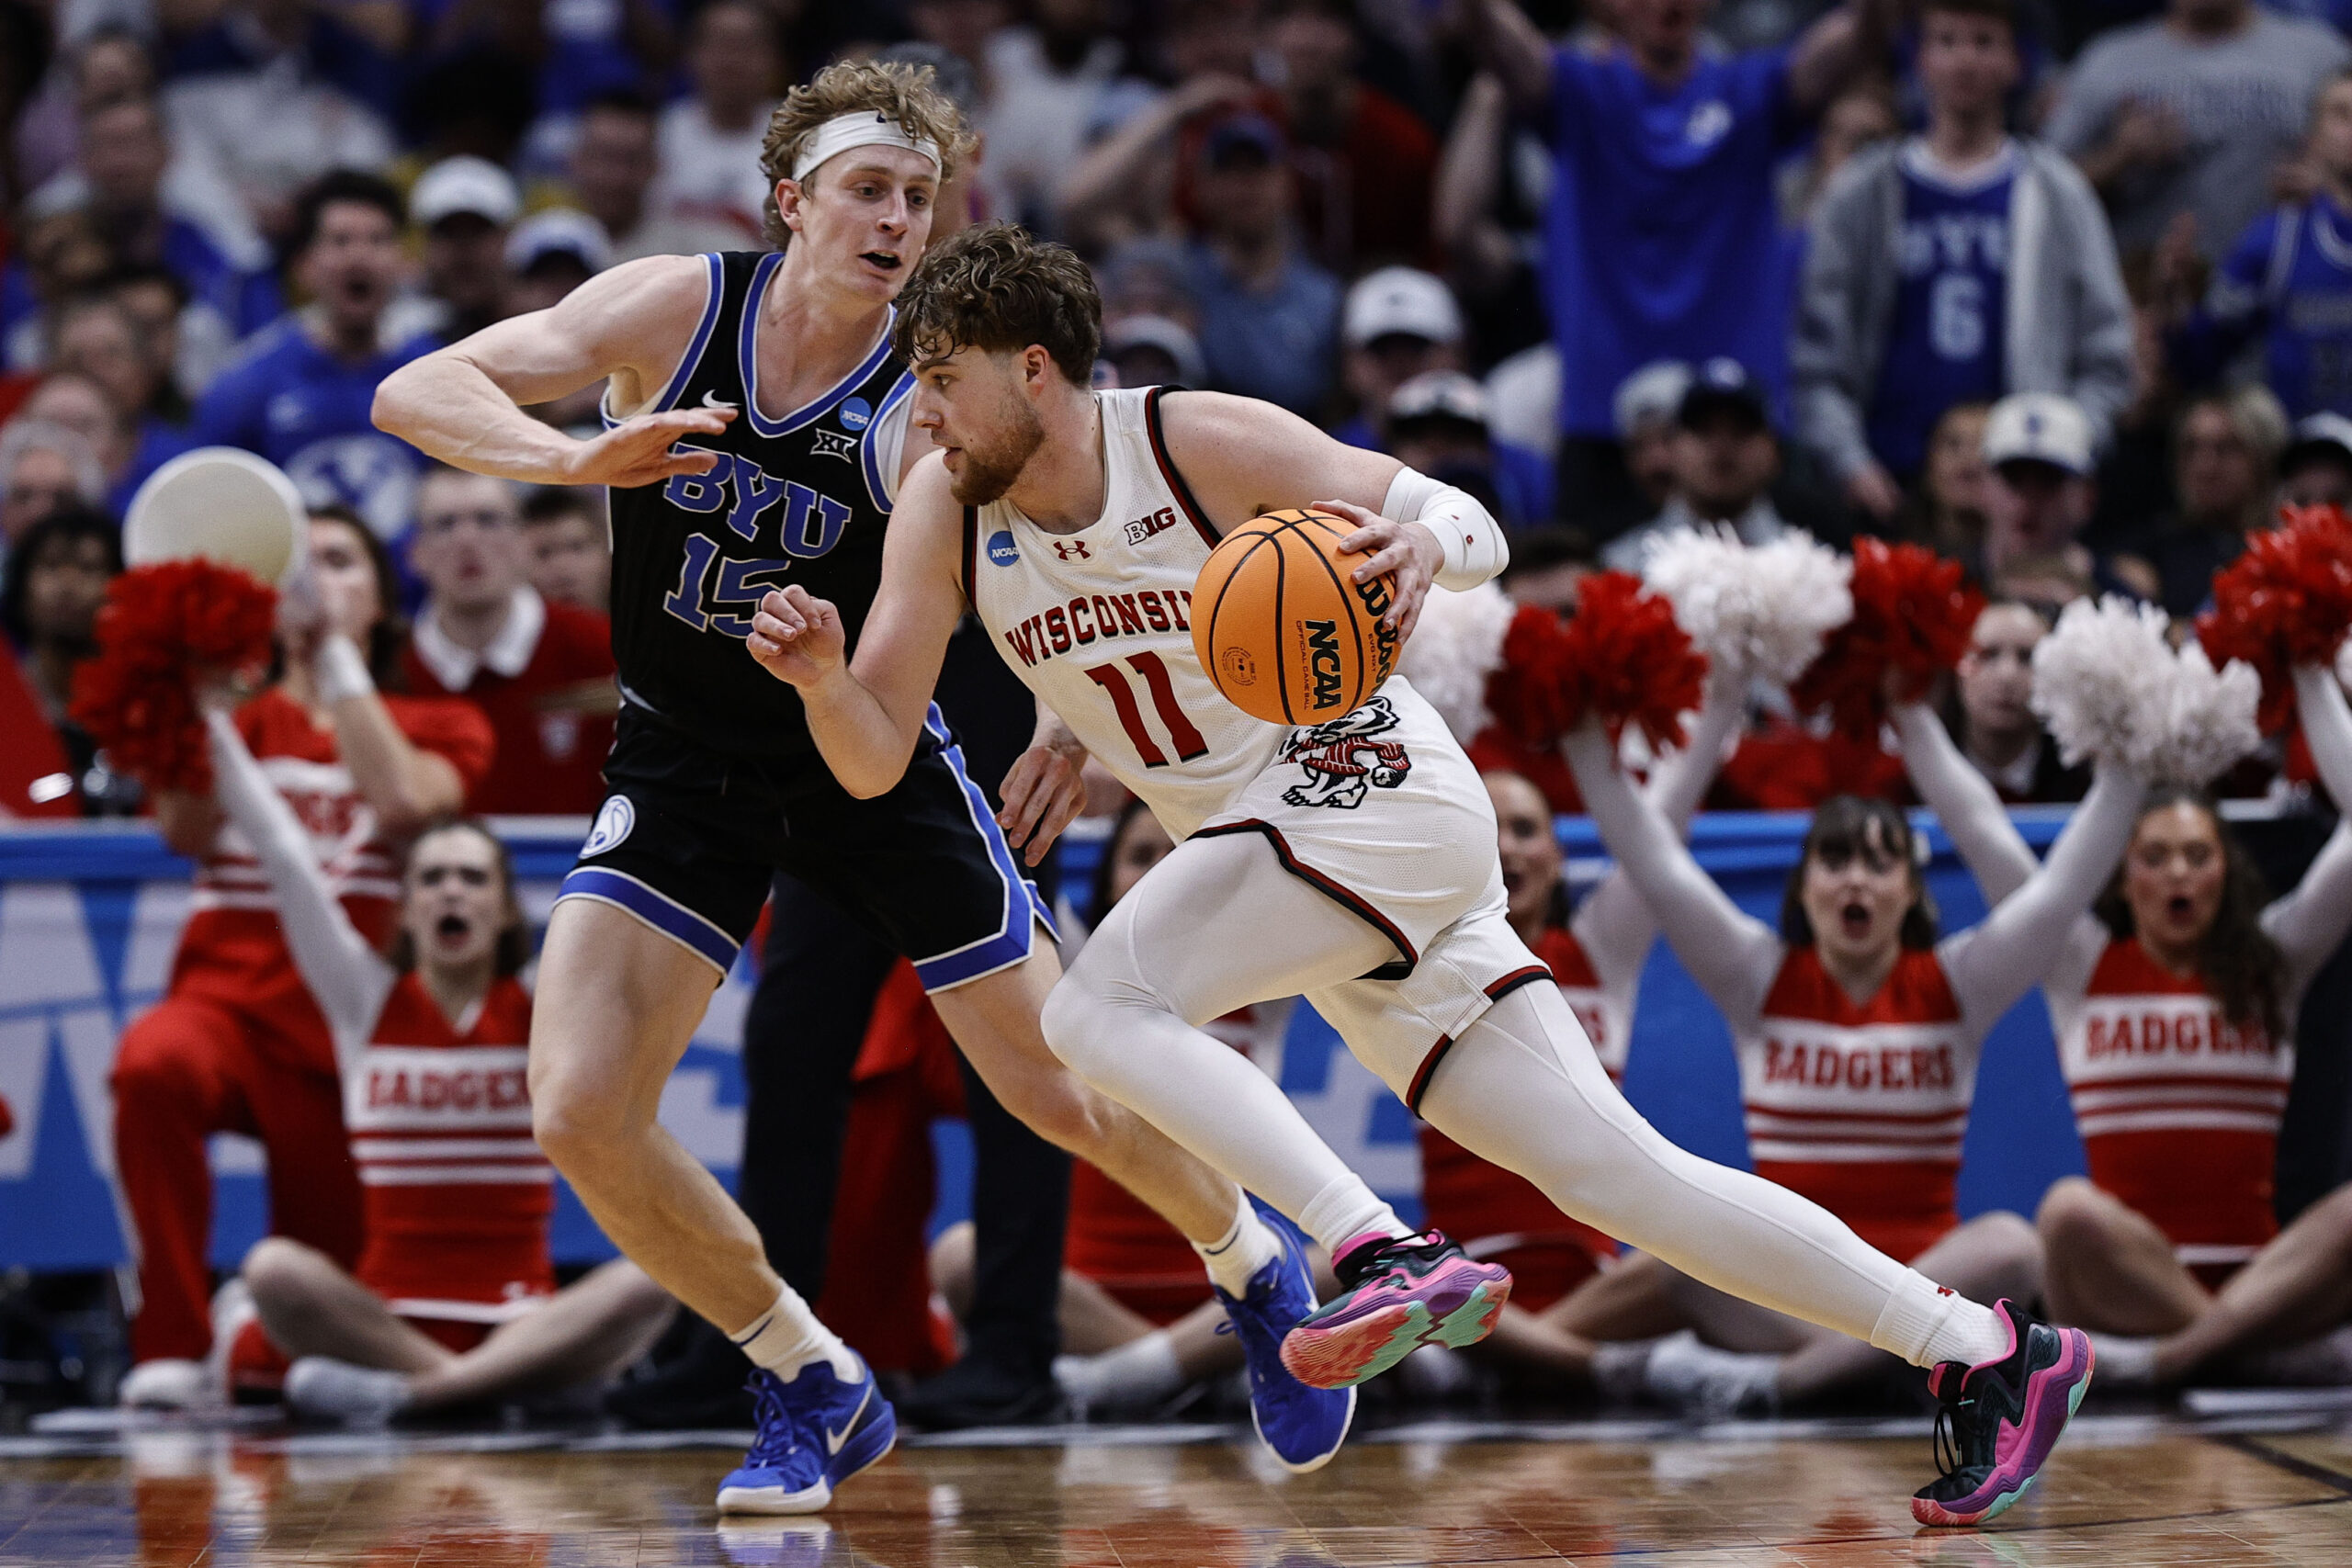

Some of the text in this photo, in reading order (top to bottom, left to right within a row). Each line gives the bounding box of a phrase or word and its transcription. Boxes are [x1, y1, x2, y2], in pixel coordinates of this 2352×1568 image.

[1930, 274, 1986, 359] 6
[662, 442, 853, 559] BYU
[662, 532, 790, 639] 15
[991, 547, 1019, 558] NCAA
[1296, 620, 1307, 664] OFFICIAL
[1302, 666, 1310, 691] GAME
[1305, 619, 1342, 710] NCAA
[1368, 633, 1376, 653] EVO
[1083, 650, 1209, 769] 11
[1765, 1039, 1960, 1089] BADGERS
